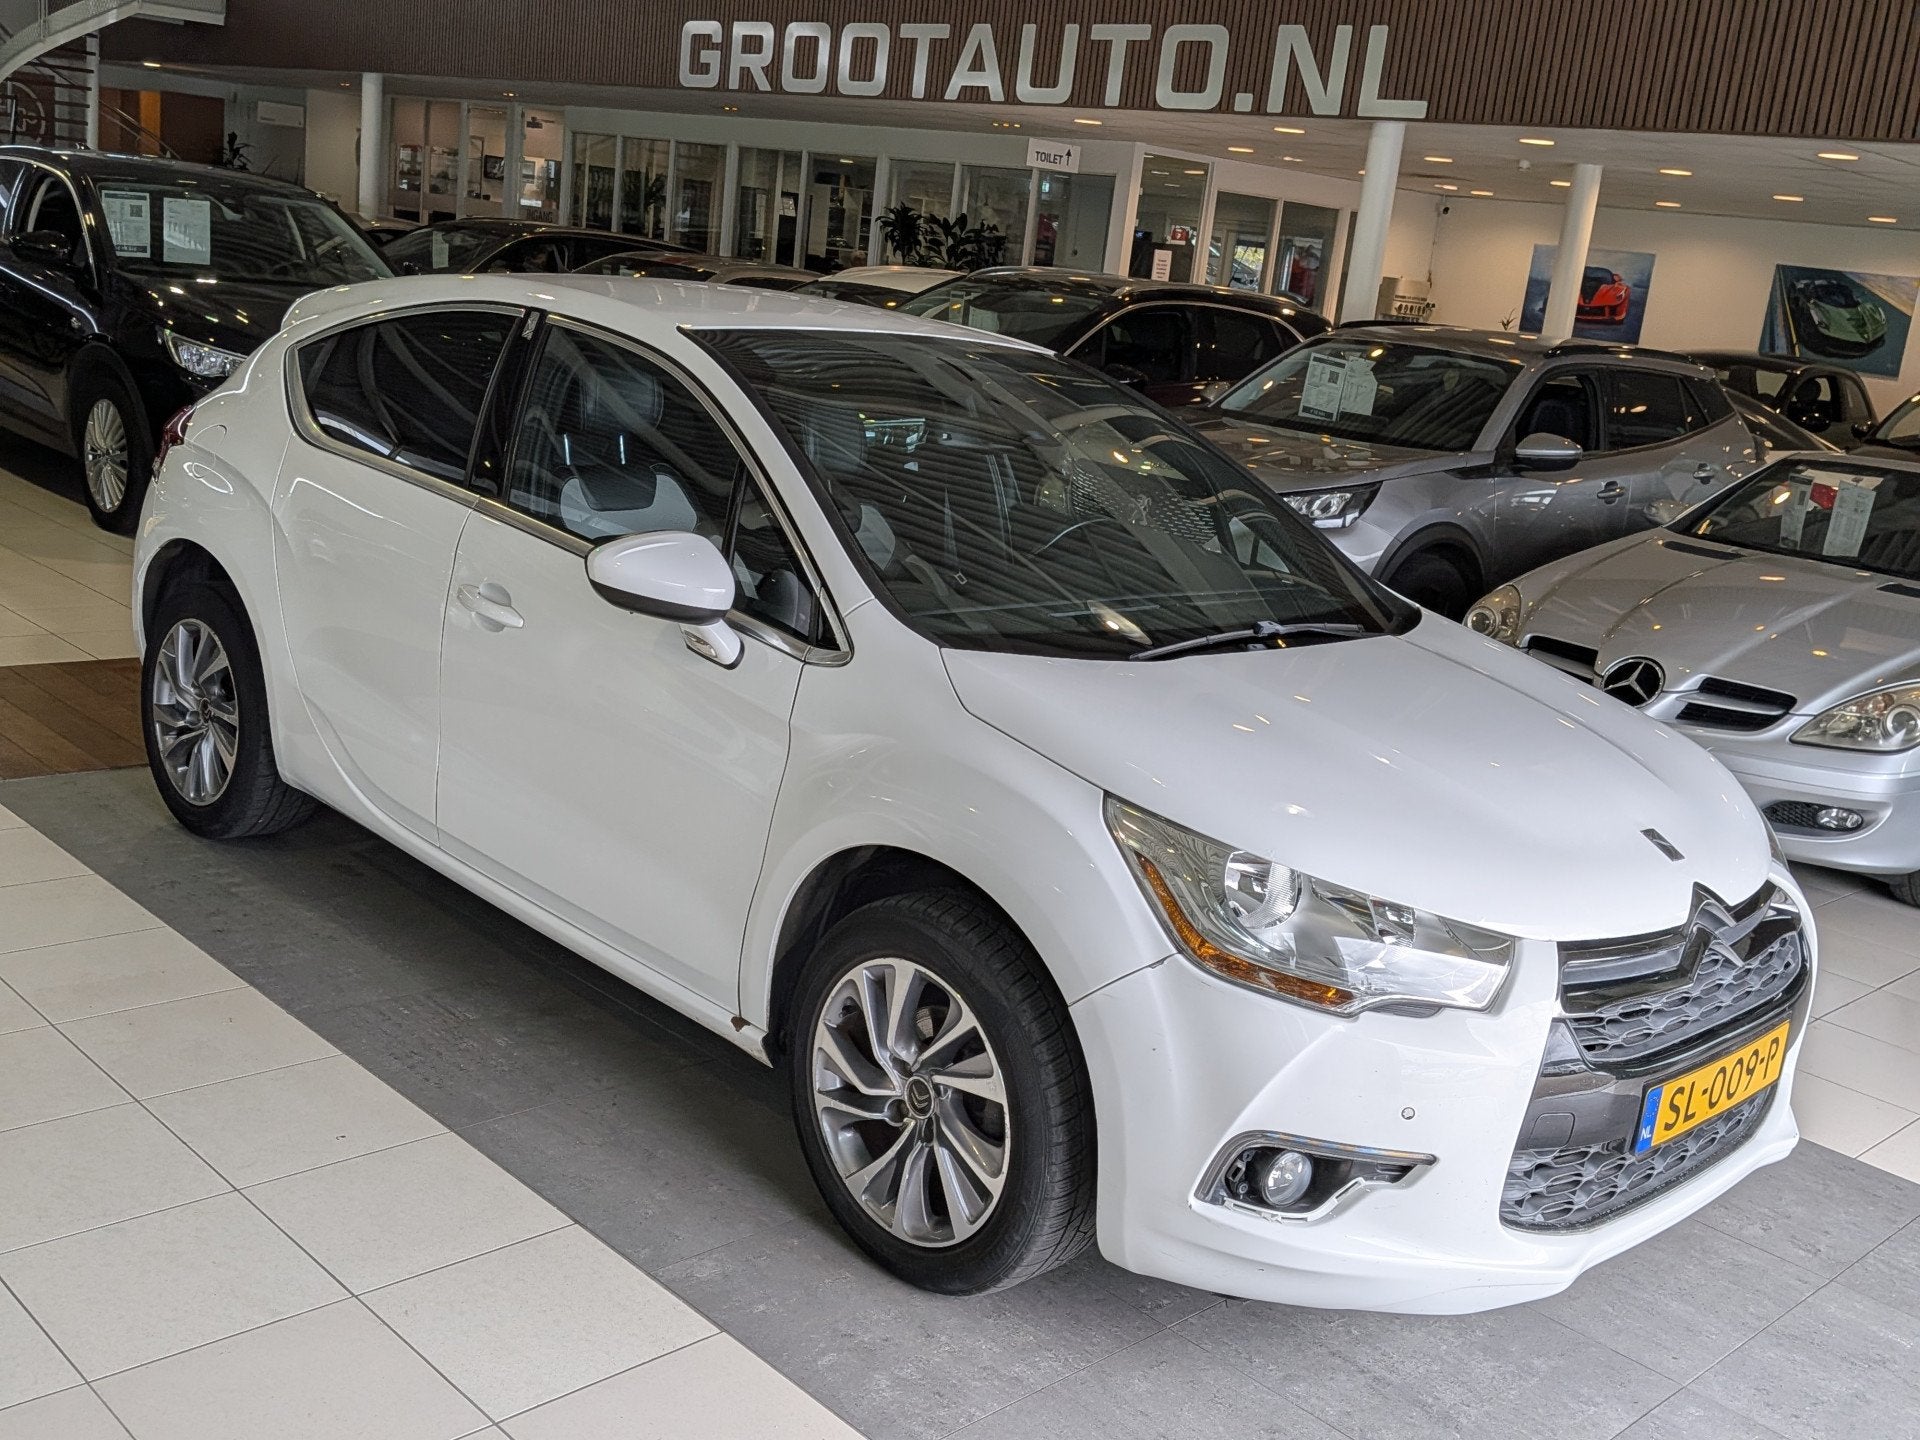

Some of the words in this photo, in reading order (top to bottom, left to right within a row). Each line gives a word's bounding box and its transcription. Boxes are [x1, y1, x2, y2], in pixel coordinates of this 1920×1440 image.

[679, 20, 1428, 119] GROOTAUTO.NL
[1035, 150, 1064, 164] TOILET
[1664, 1036, 1780, 1131] SL-009-P
[1640, 1125, 1652, 1141] NL
